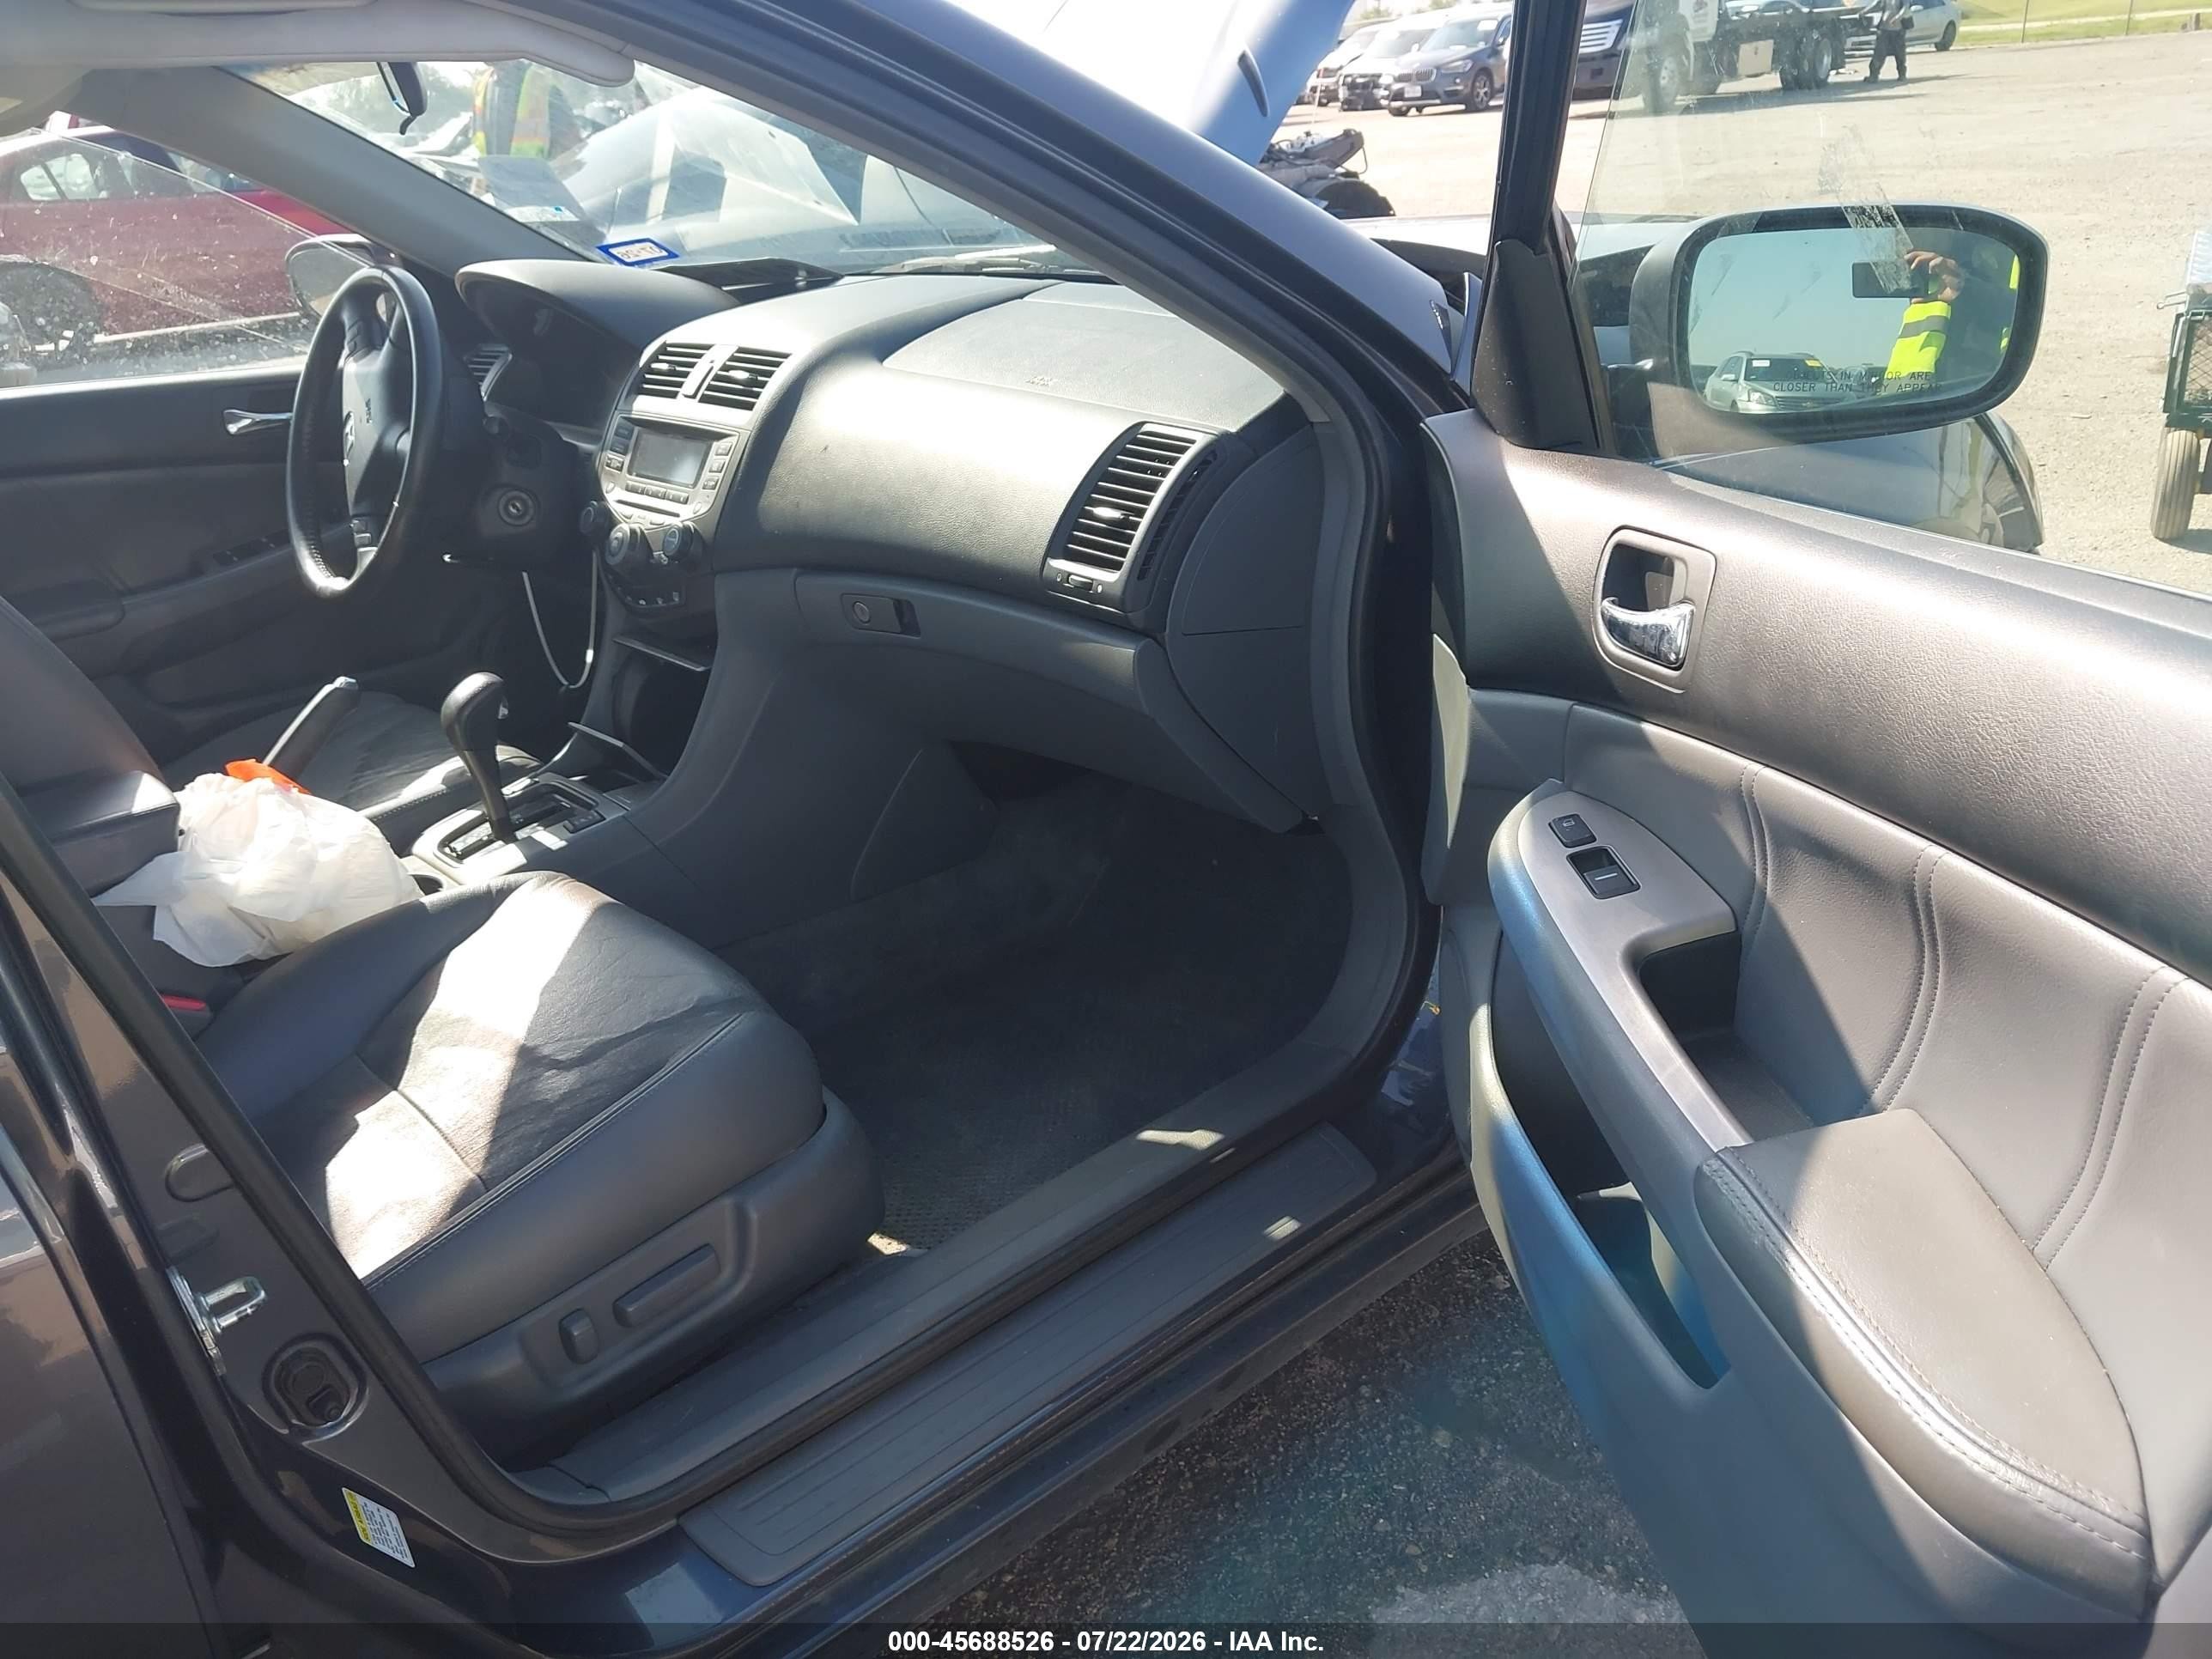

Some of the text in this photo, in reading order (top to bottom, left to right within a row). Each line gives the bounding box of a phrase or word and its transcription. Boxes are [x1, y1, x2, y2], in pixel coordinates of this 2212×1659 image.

[1840, 371, 1852, 380] IN
[1859, 370, 1902, 380] MROR
[1909, 371, 1932, 380] ARE
[1773, 382, 1816, 392] CLOSER
[1824, 383, 1853, 392] THAN
